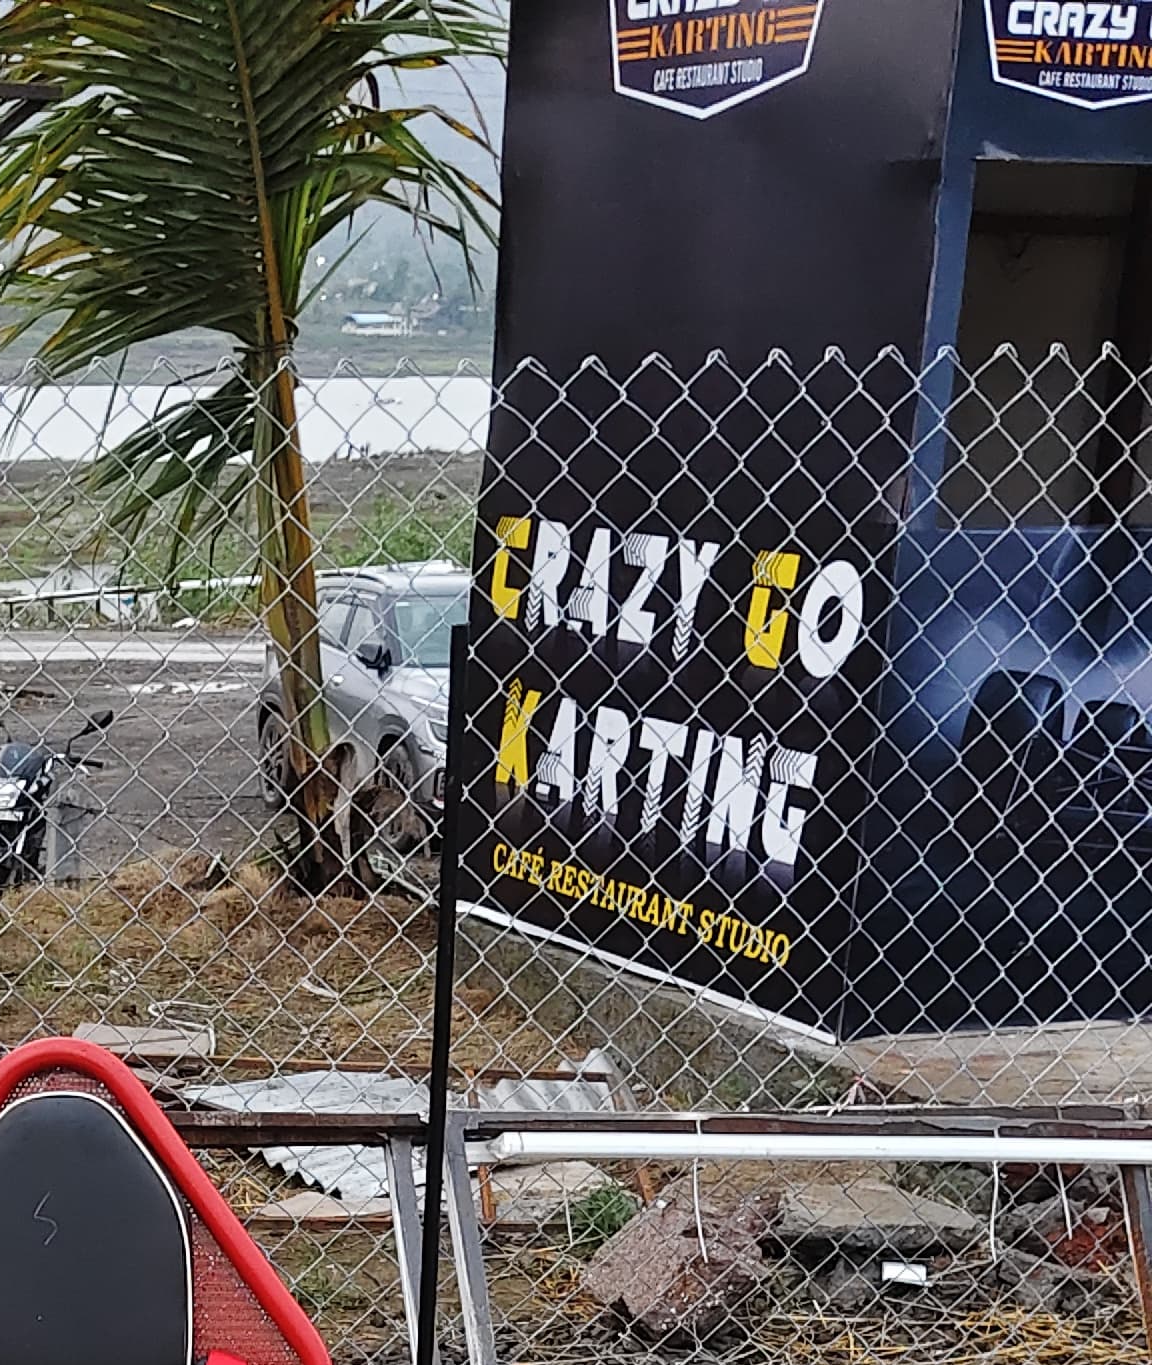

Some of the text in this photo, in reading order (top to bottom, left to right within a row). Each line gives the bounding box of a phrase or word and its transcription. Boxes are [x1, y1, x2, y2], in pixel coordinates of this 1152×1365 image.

[649, 9, 777, 59] KARTING
[1008, 1, 1137, 40] CRAZY
[653, 57, 764, 92] CAFE RESTAURANT STUDIO
[1034, 39, 1152, 69] KARTIN
[1038, 70, 1063, 87] CAFE
[1063, 71, 1121, 89] RESTAURANT
[491, 516, 863, 678] CRAZY GO
[495, 676, 818, 866] KARTING
[493, 843, 791, 968] CAFÉ RESTAURANT STUDIO
